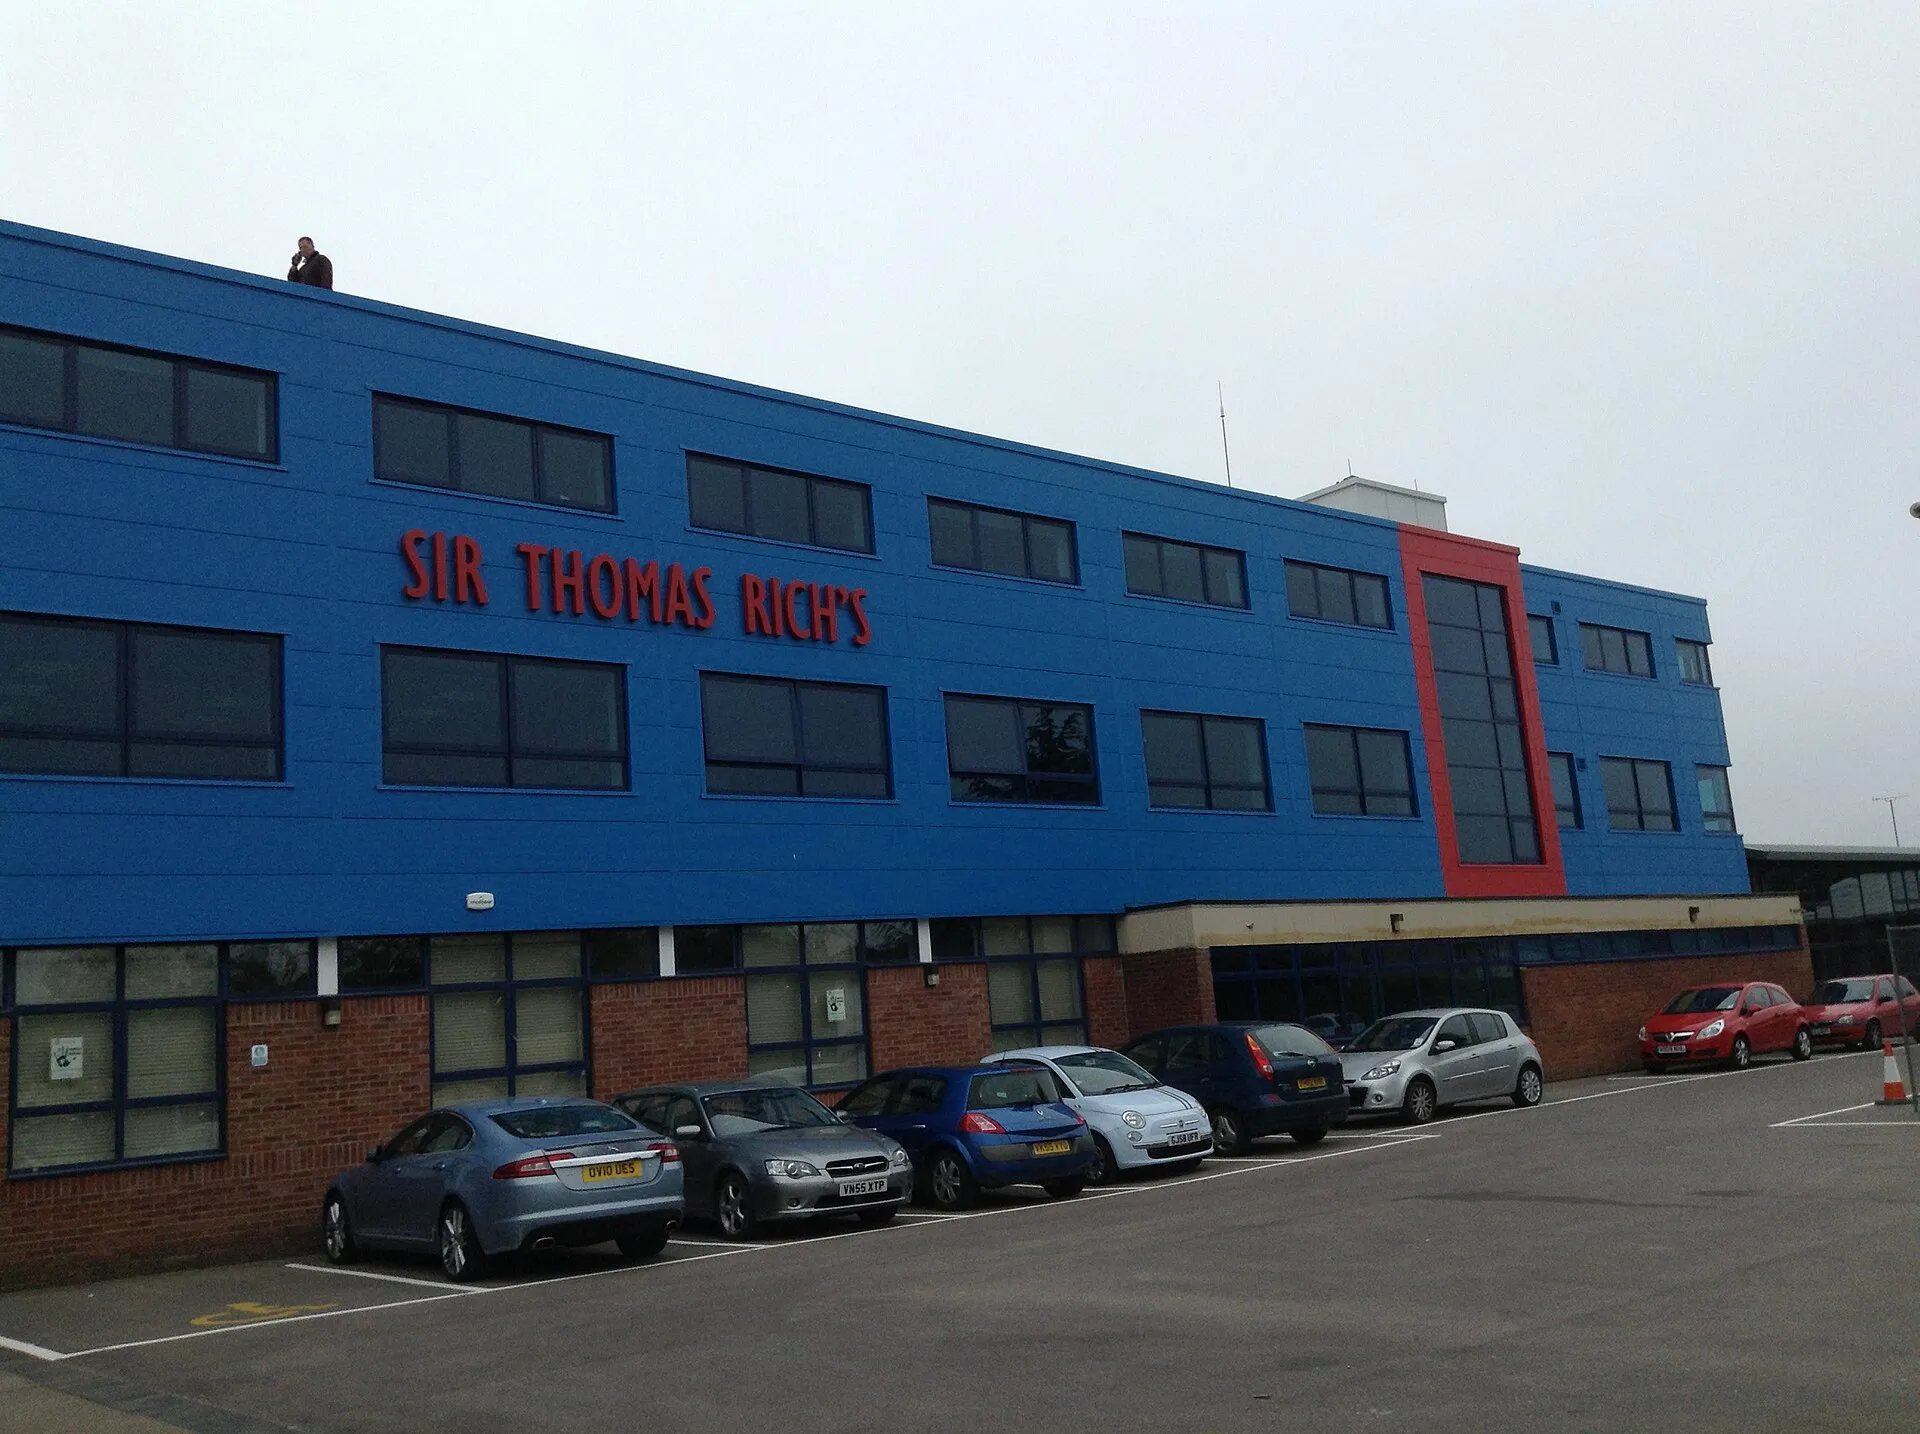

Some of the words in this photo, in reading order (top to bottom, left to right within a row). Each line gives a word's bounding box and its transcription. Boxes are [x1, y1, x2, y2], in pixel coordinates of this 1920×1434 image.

[399, 528, 489, 605] SIR
[516, 543, 717, 630] THOMAS
[740, 573, 873, 646] RICH'S
[588, 1165, 613, 1178] OV10
[615, 1163, 635, 1175] UES
[843, 1183, 866, 1195] VN55
[868, 1181, 885, 1192] XTP
